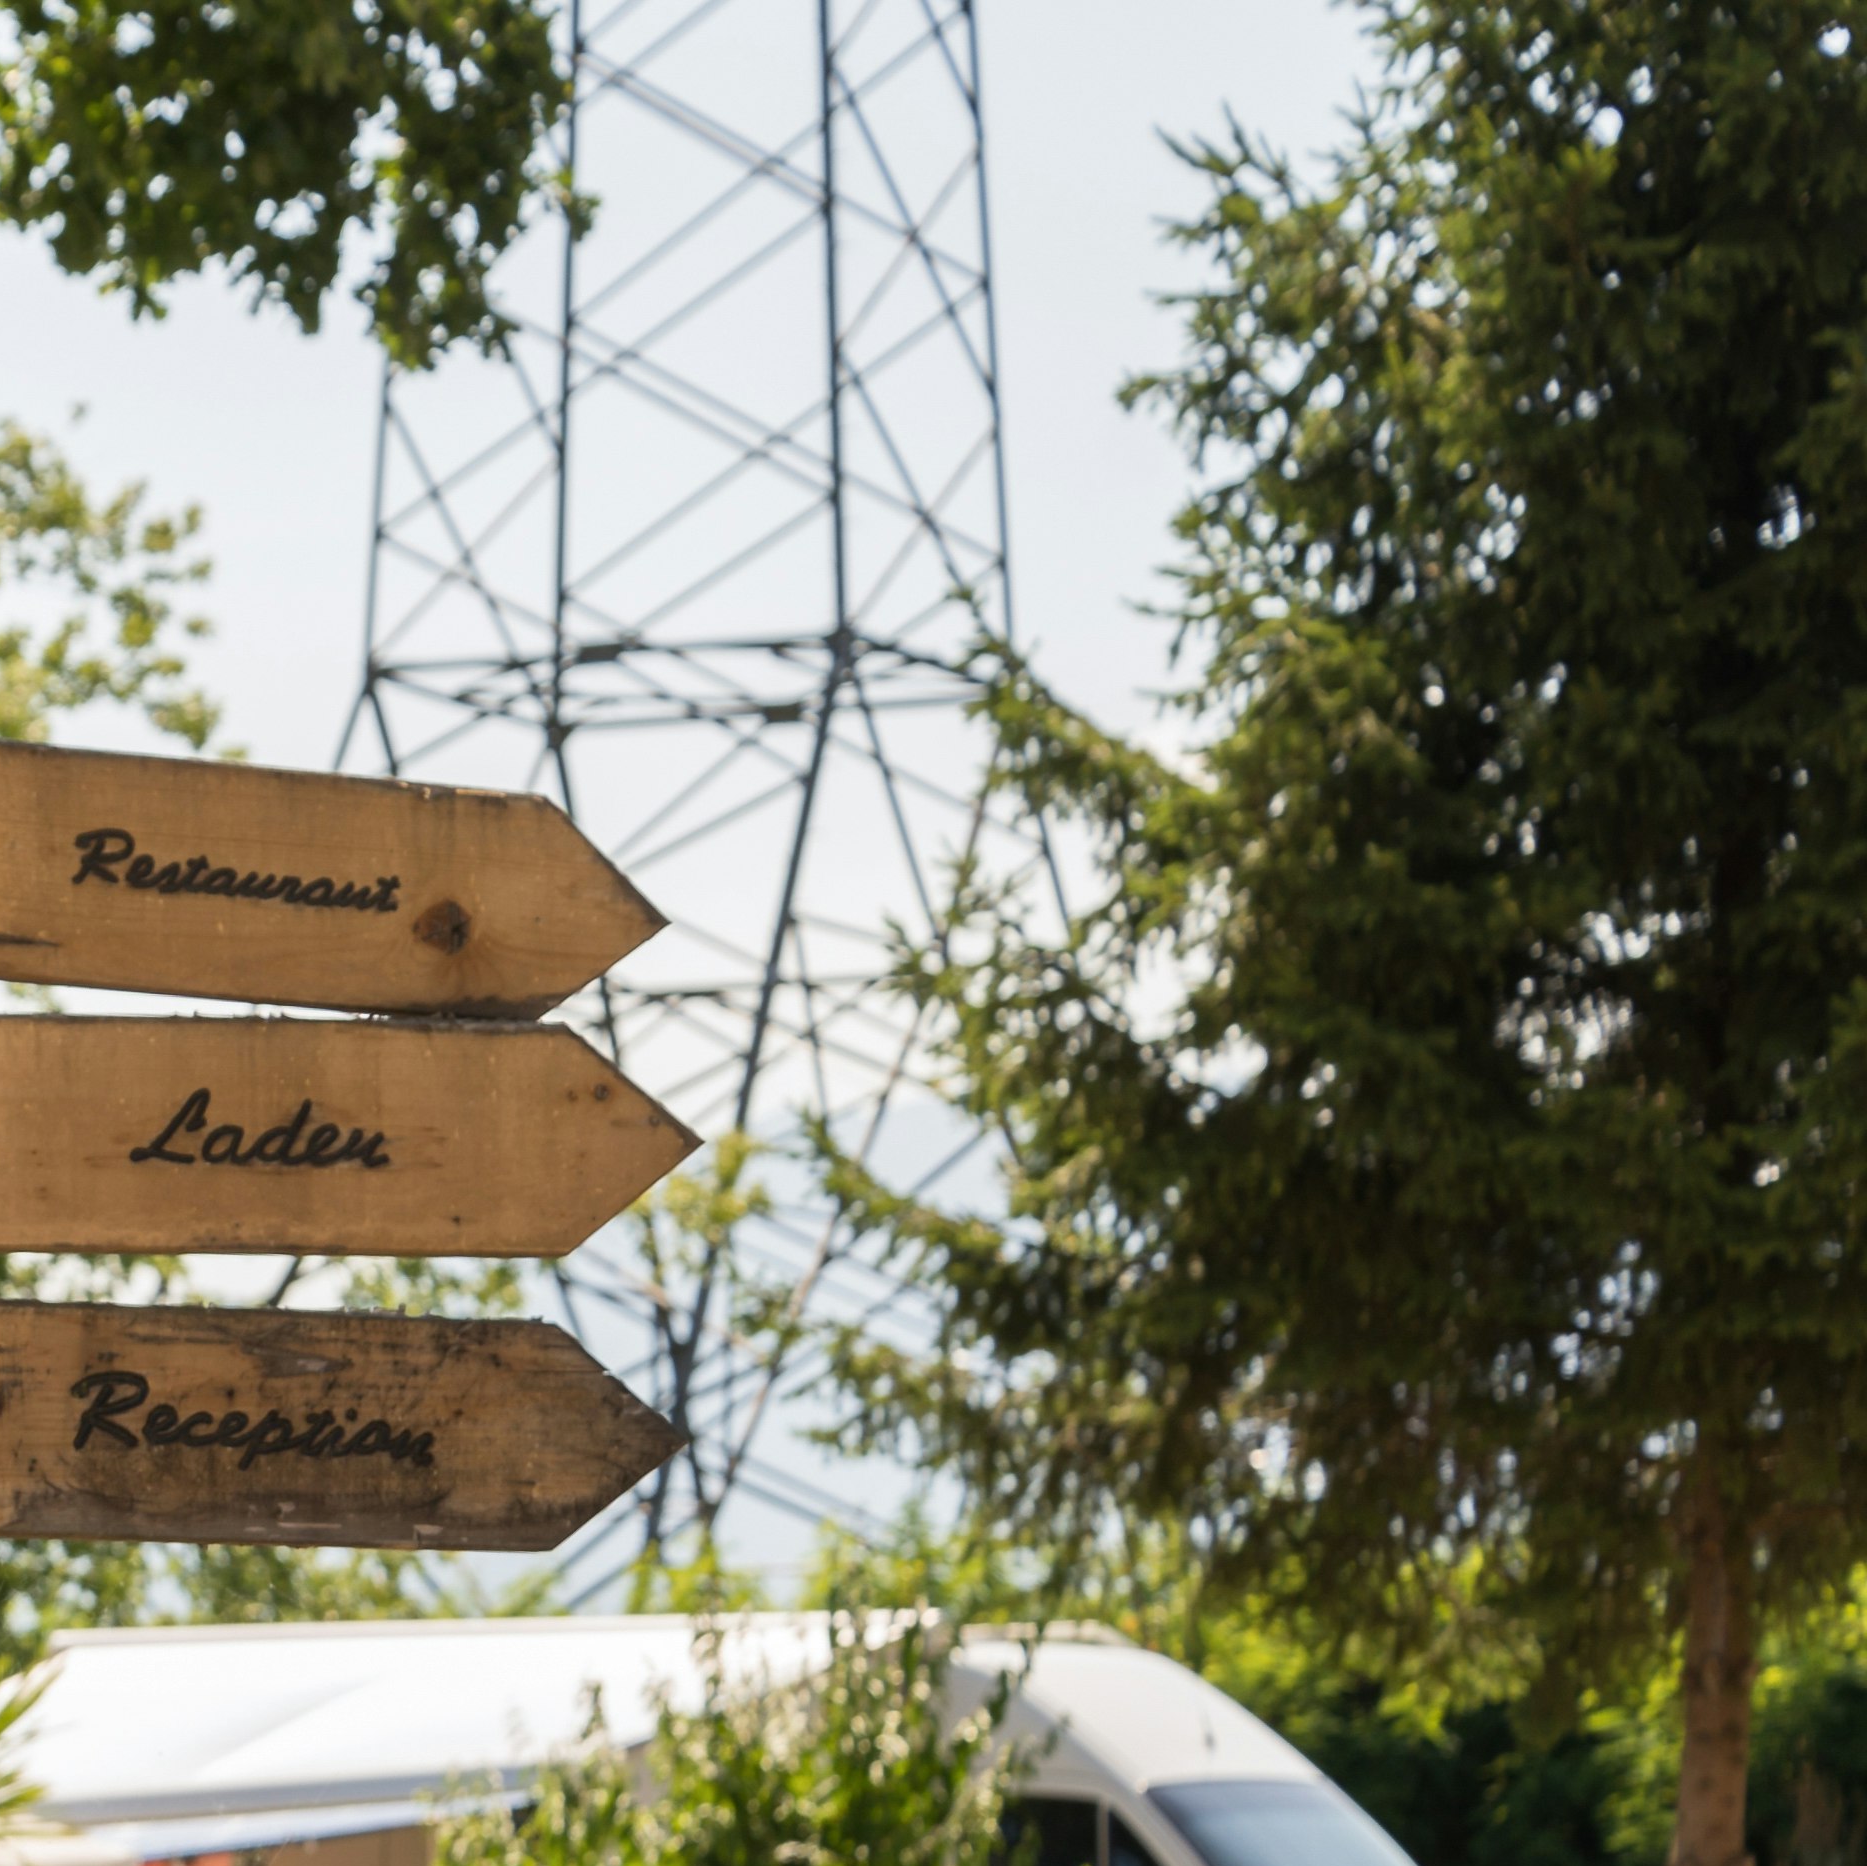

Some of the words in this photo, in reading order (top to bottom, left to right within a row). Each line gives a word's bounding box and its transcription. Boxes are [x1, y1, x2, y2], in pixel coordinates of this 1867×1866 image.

[72, 828, 400, 912] Restaurant
[130, 1087, 390, 1168] Laden
[70, 1371, 435, 1470] Reception
